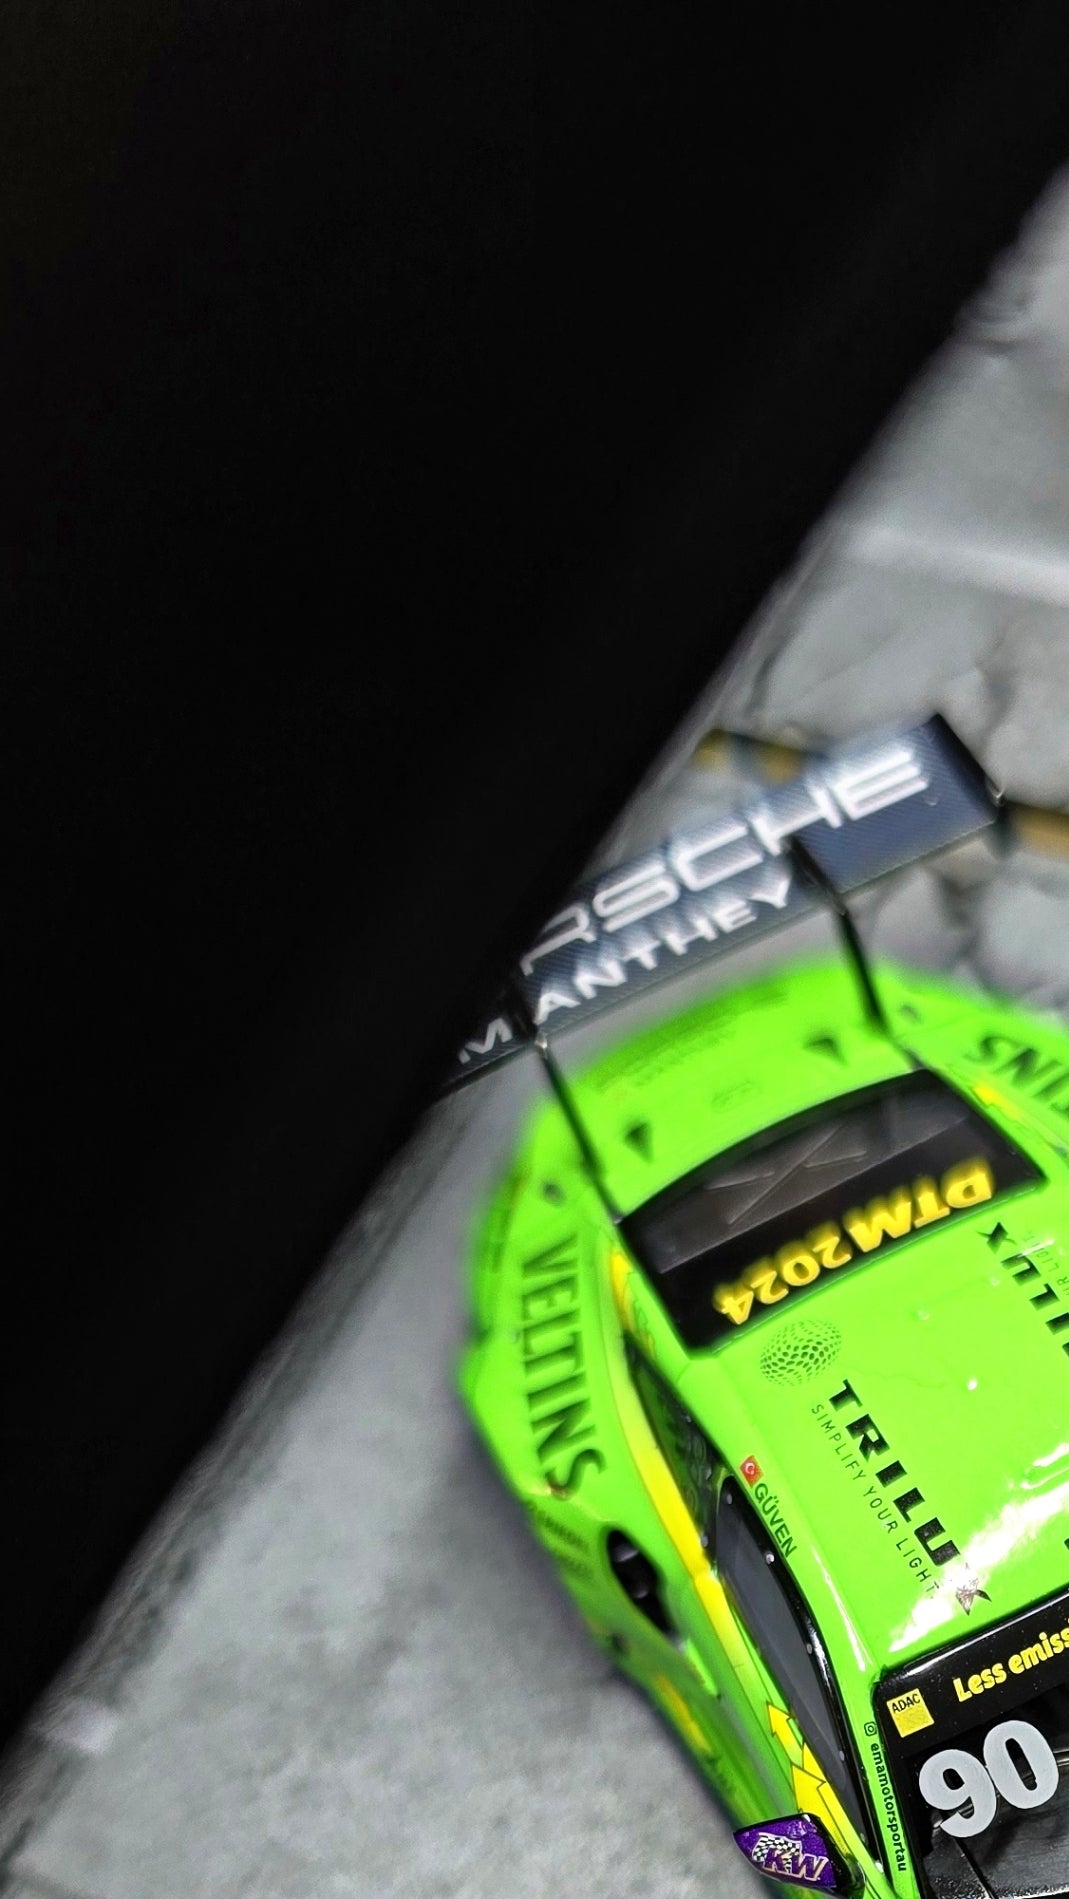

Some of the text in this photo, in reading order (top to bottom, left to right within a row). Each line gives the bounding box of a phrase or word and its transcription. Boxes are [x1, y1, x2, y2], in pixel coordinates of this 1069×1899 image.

[458, 876, 791, 1064] MANTHEY
[713, 1158, 993, 1326] DTM 2024
[521, 1233, 607, 1499] VELTINS
[754, 1483, 798, 1558] GÜVEN
[811, 1403, 867, 1481] SIMPLIFY
[863, 1485, 899, 1534] YOUR
[891, 1692, 922, 1715] ADAC
[952, 1660, 1007, 1703] Less
[871, 1742, 907, 1872] emamotorsportau
[918, 1719, 1060, 1839] 90
[761, 1847, 830, 1882] KW
